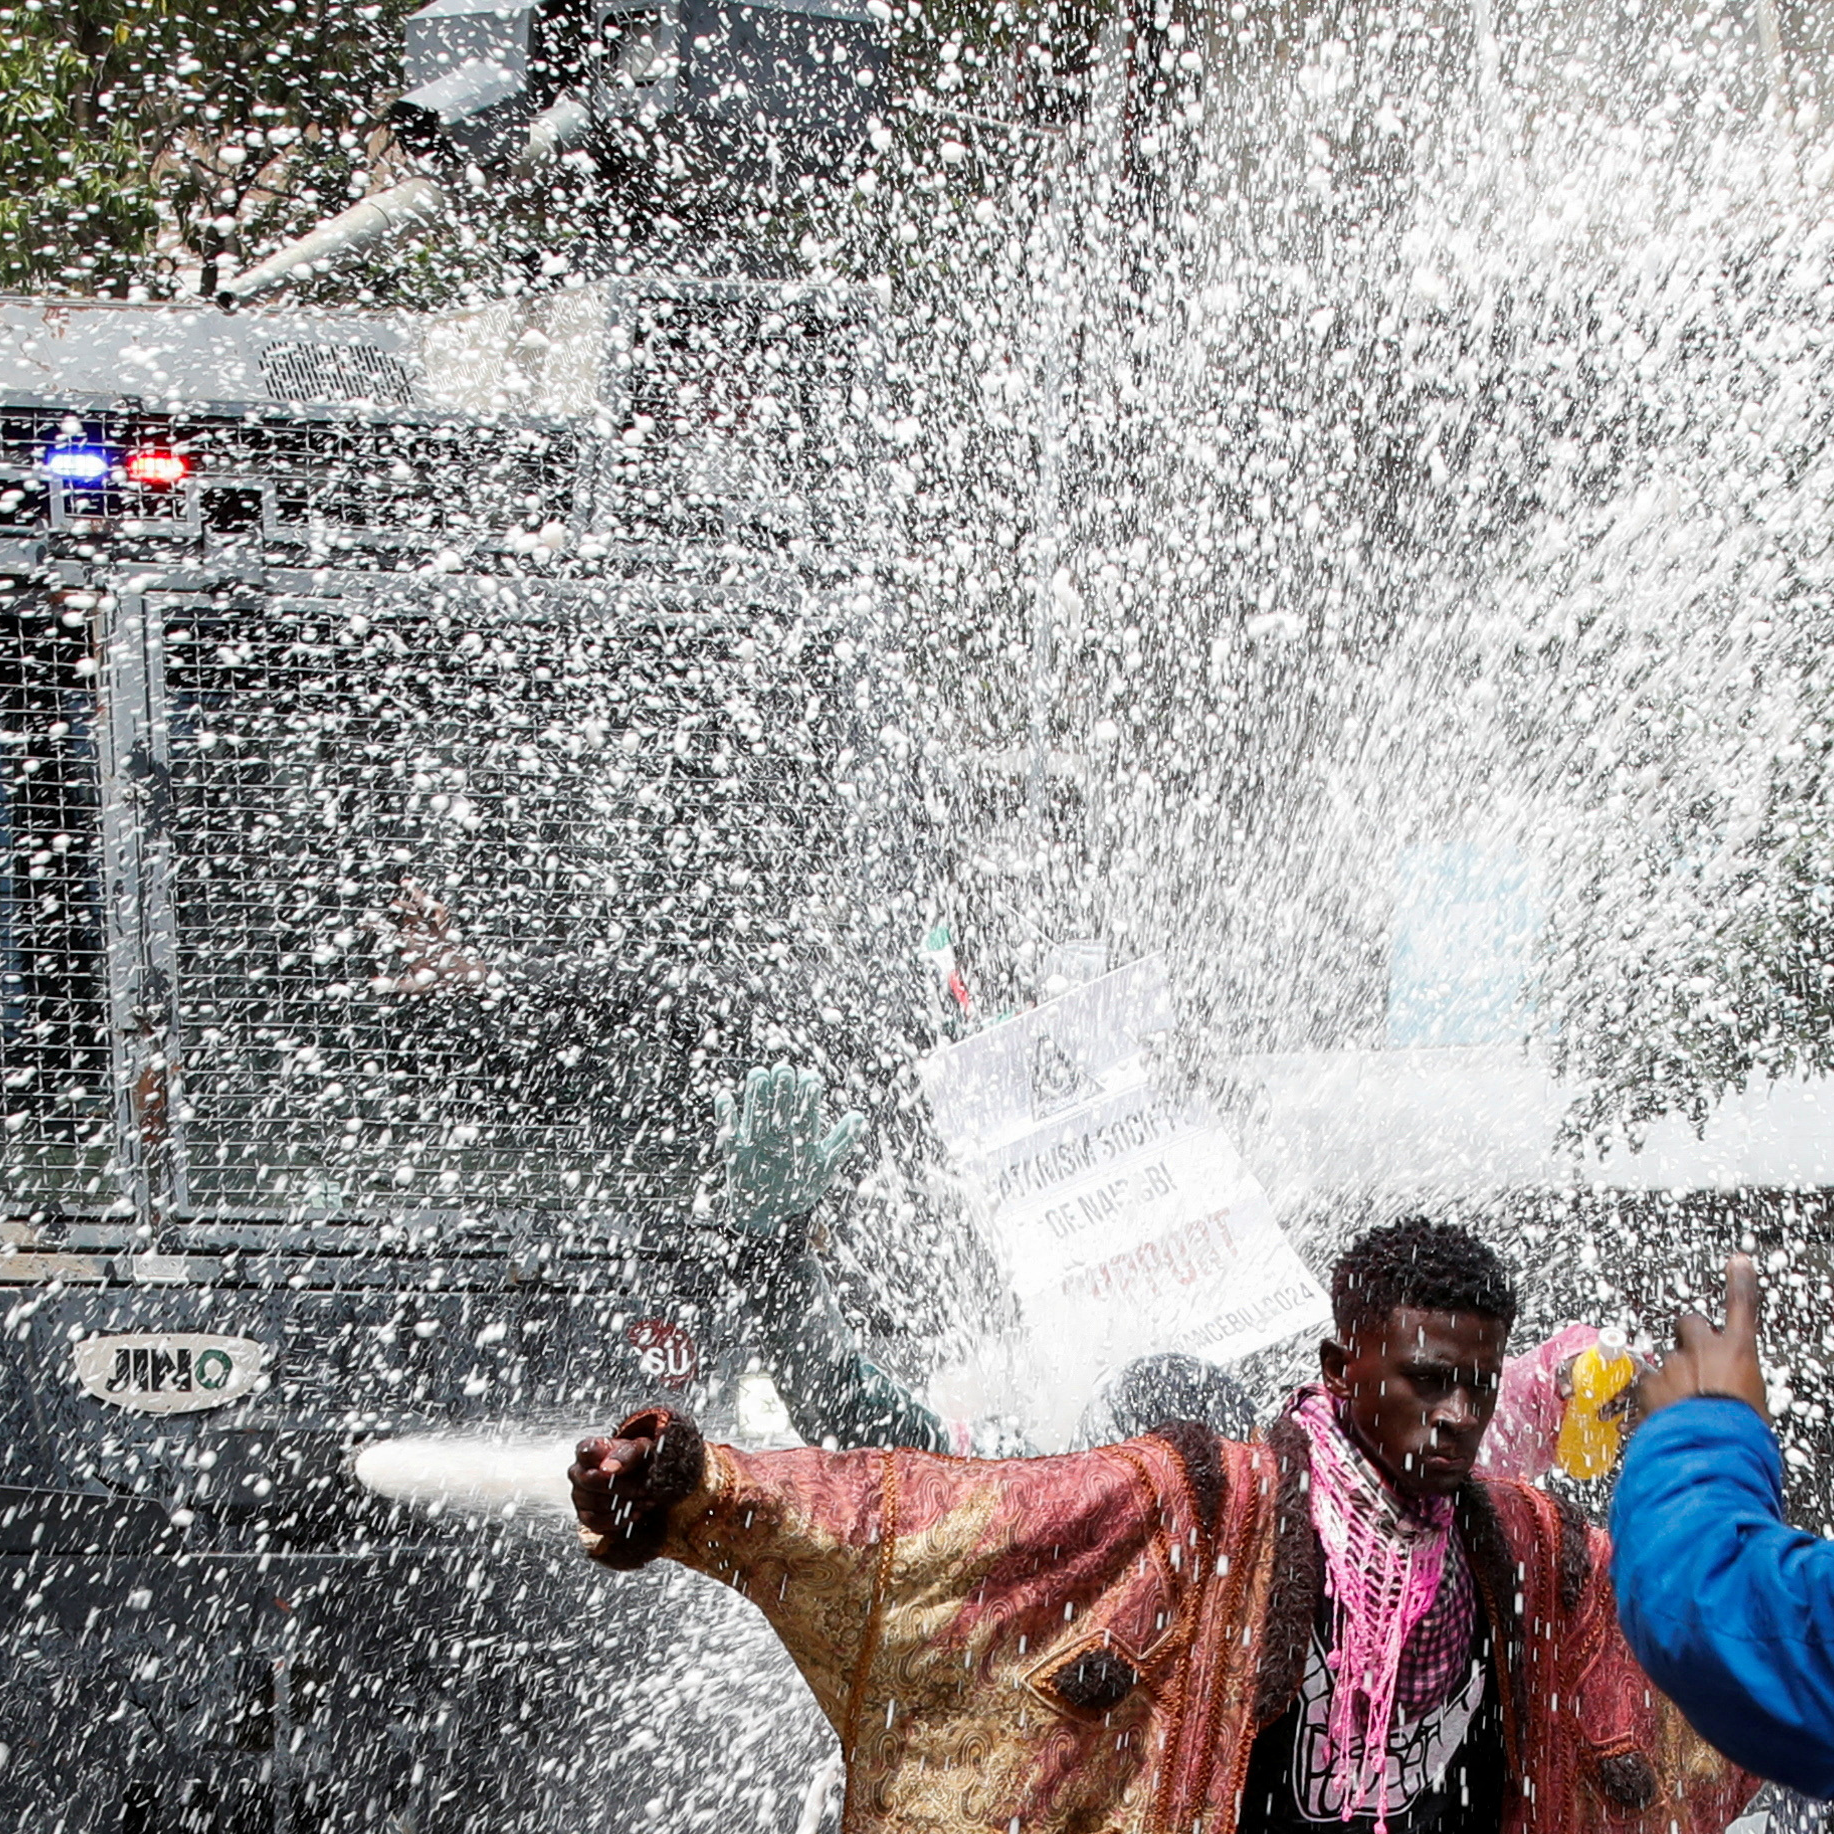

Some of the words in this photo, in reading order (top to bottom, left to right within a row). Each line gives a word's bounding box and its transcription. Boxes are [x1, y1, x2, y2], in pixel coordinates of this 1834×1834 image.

[1044, 1202, 1078, 1239] OF
[1062, 1207, 1238, 1300] UPPORT
[105, 1349, 233, 1392] JINO
